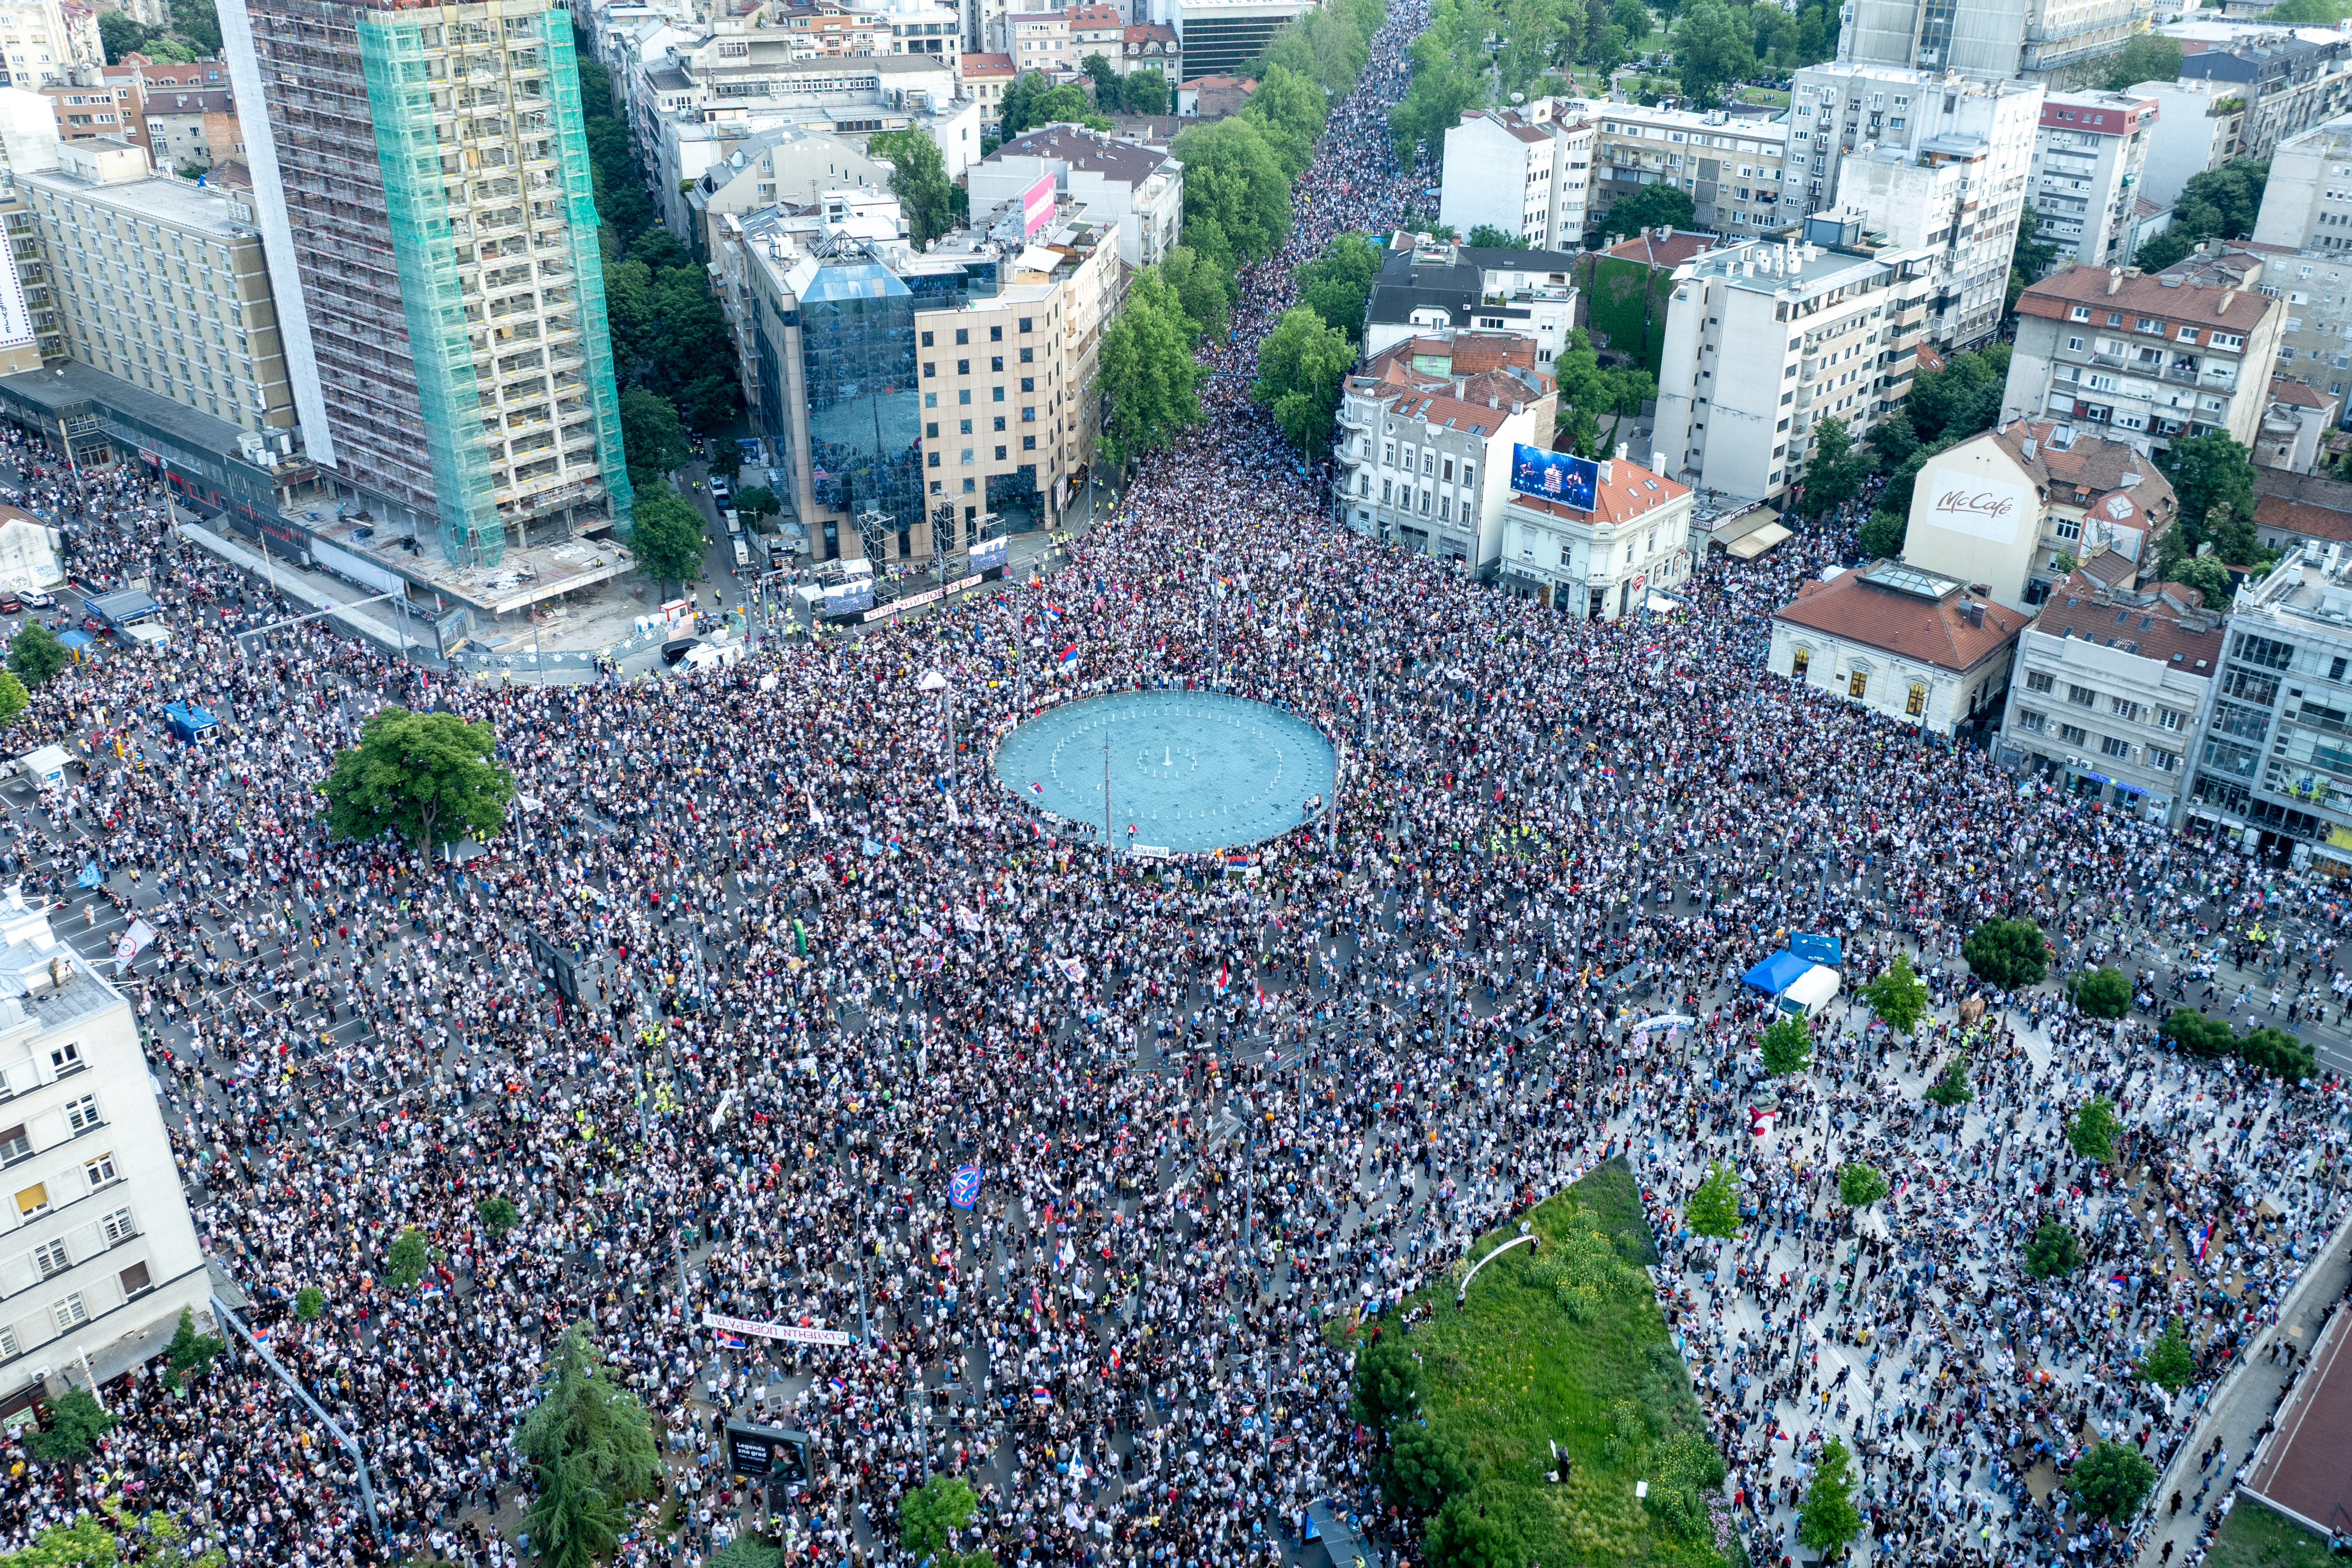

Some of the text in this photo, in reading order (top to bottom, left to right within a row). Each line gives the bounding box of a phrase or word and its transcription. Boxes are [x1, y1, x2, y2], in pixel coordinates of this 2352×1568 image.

[1025, 187, 1053, 225] emmezeta
[1936, 491, 2013, 518] McCafé
[869, 596, 920, 619] СТУДНТИ
[2089, 772, 2147, 796] BENU Apoteka
[736, 1442, 765, 1452] Legenda
